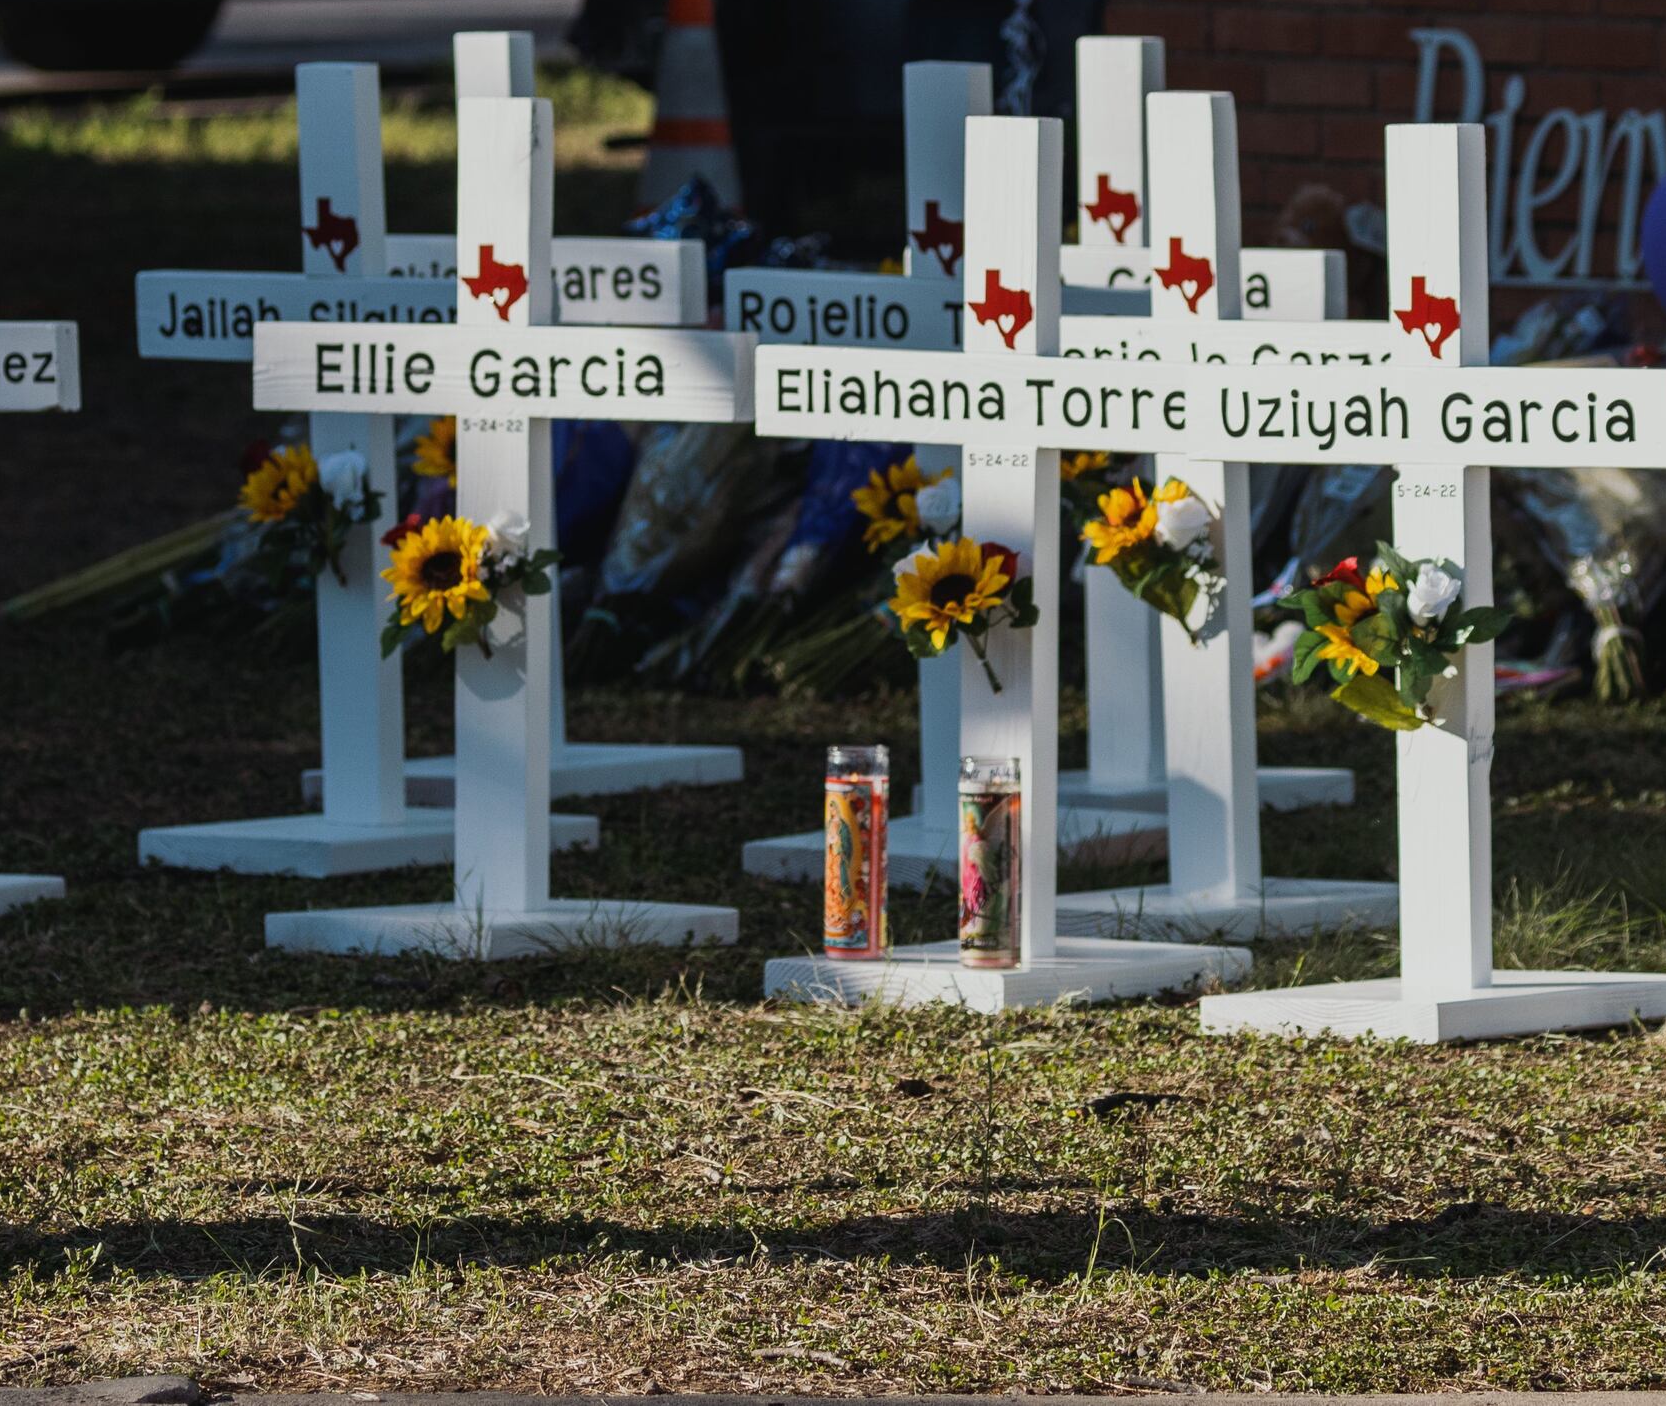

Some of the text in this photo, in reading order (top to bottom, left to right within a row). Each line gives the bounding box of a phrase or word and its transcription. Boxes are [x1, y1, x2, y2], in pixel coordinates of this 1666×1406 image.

[740, 290, 909, 346] Rojelio
[315, 343, 666, 399] Ellie Garcia
[776, 368, 1006, 422] Eliahana
[462, 419, 525, 434] 5-24-22
[1220, 387, 1637, 452] Uziyah Garcia
[968, 452, 1031, 468] 5-24-22
[1397, 483, 1458, 498] 5-24-22
